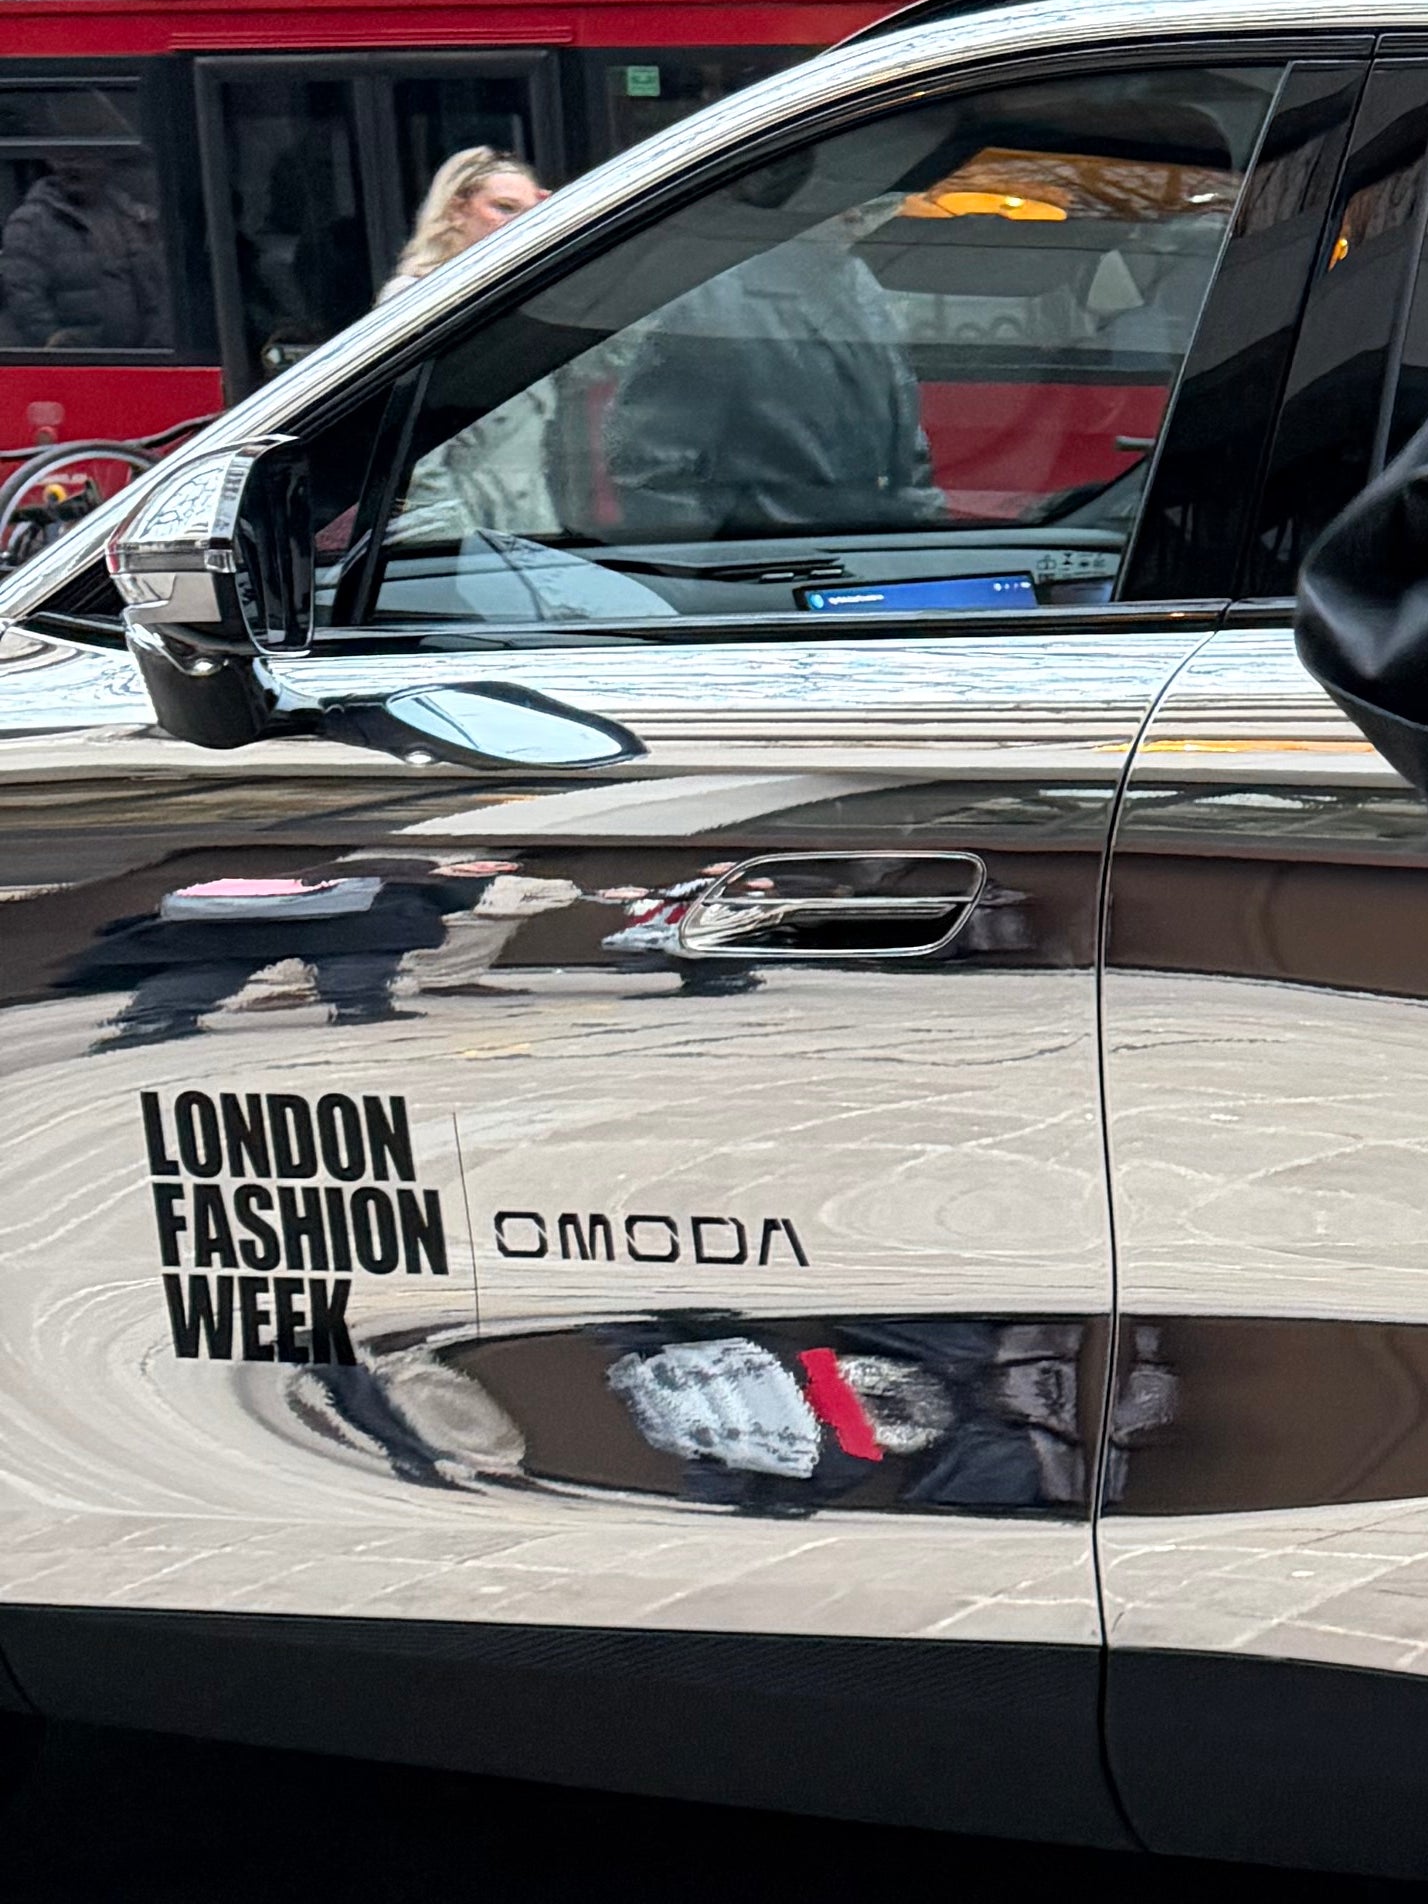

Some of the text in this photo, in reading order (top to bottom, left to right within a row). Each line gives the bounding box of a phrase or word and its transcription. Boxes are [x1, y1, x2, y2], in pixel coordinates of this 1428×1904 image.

[141, 1090, 416, 1182] LONDON
[152, 1182, 449, 1275] FASHION
[494, 1211, 810, 1267] OMODA
[162, 1273, 356, 1366] WEEK
